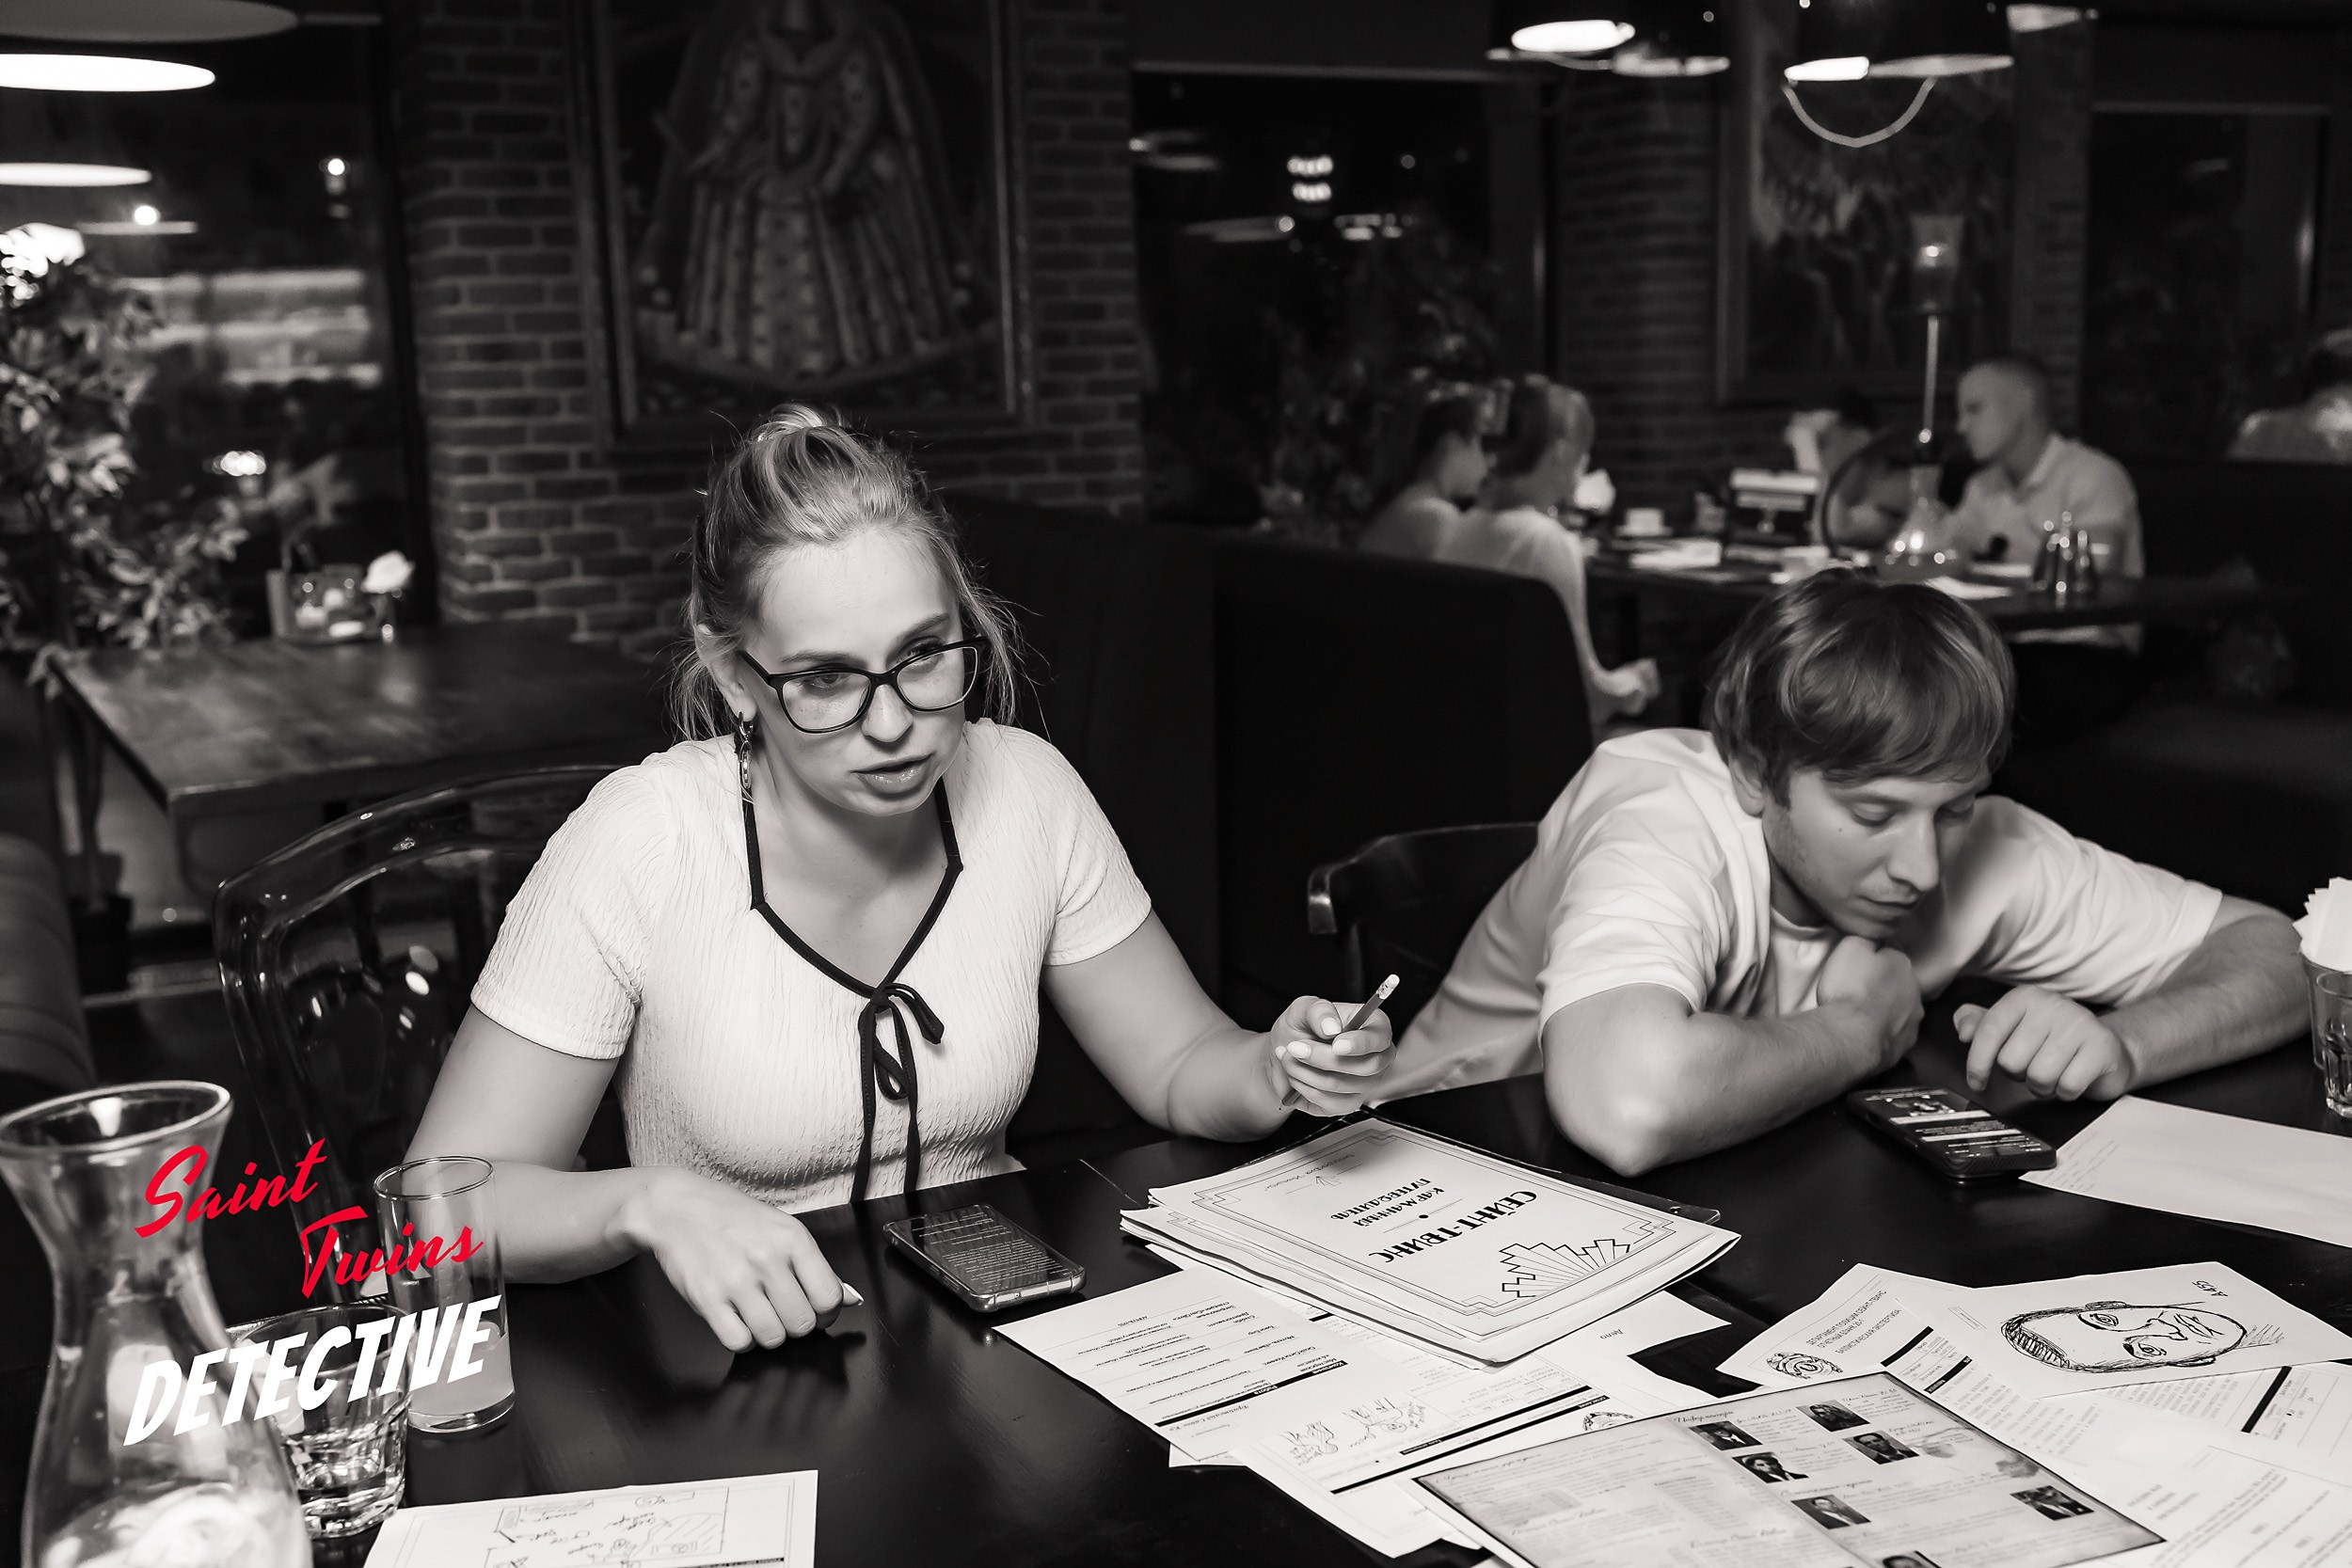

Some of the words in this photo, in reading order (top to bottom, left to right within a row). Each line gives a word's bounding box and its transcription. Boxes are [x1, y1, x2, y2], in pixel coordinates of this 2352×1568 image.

[1330, 1178, 1431, 1220] ПУТЕВОДИТЕЛЬ
[1353, 1187, 1444, 1227] КАРМАННЫЙ
[1369, 1191, 1537, 1263] СЕЙНТ-ТВИНС
